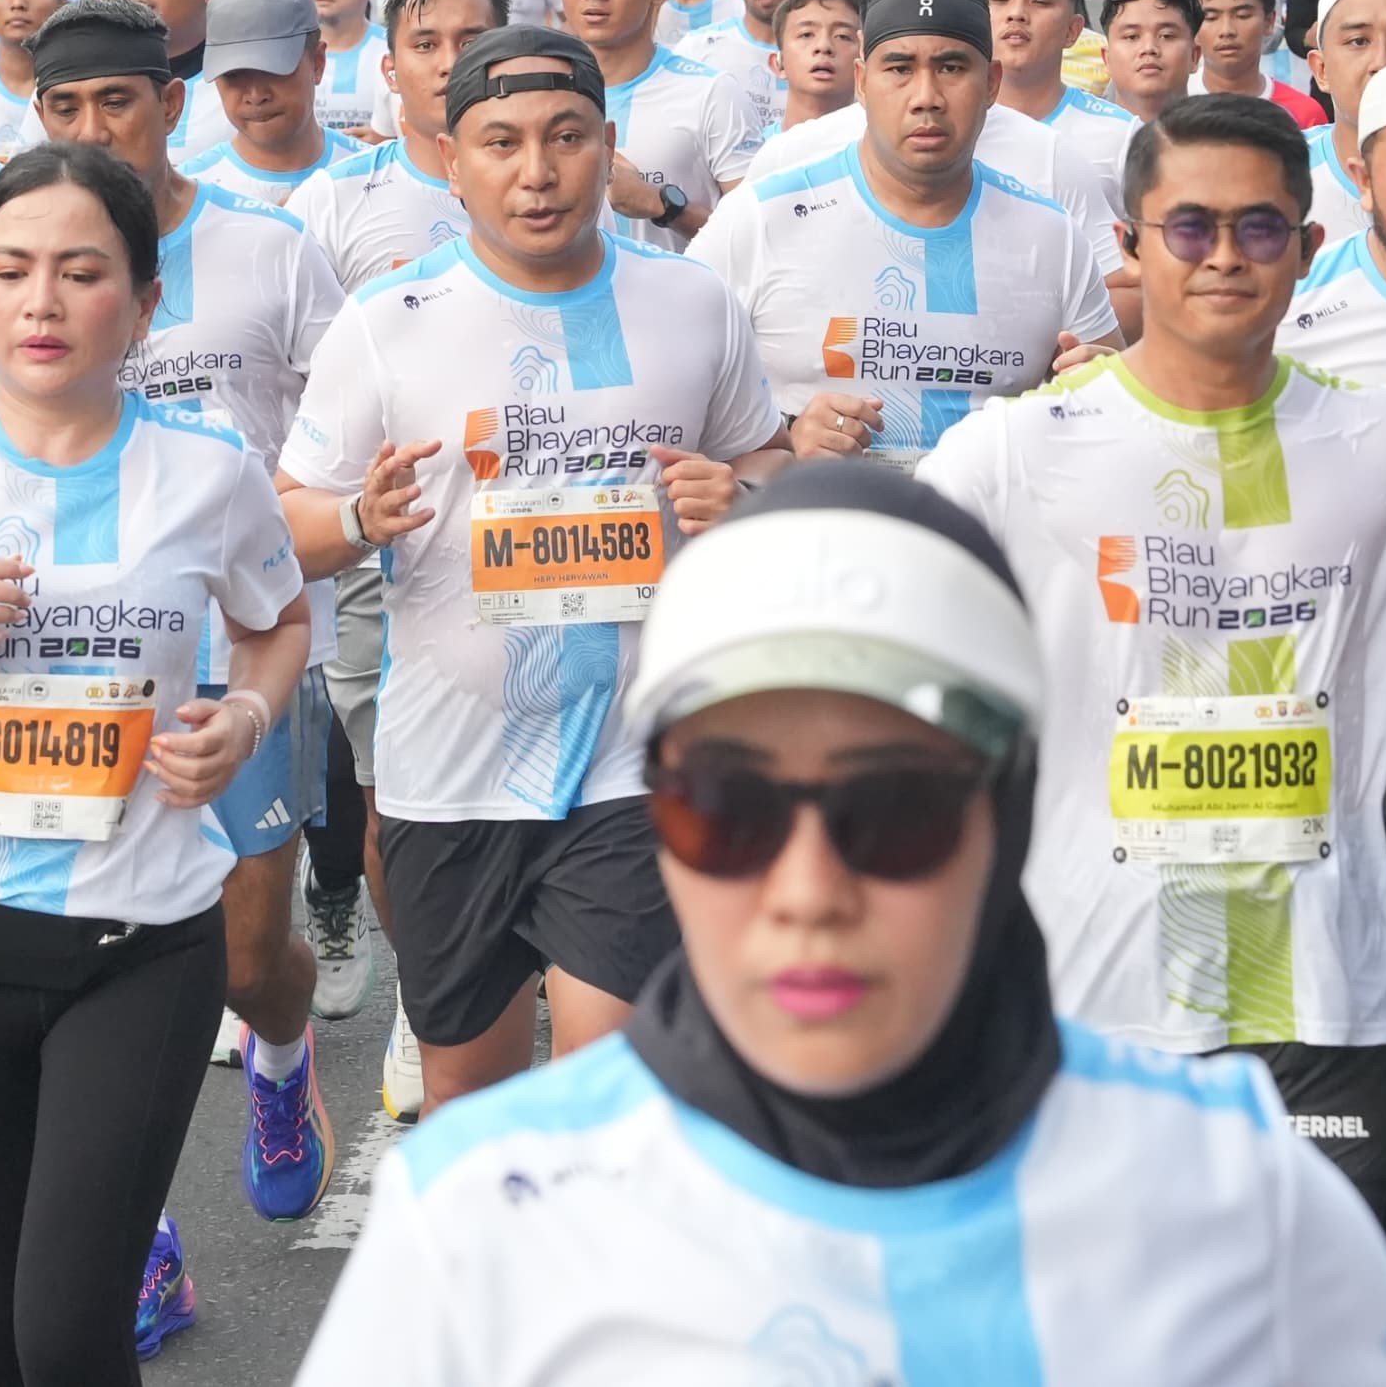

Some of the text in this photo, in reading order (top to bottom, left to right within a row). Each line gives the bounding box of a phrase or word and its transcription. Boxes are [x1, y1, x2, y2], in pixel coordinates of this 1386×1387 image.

[1085, 99, 1116, 114] 10K
[997, 174, 1039, 198] 10K
[810, 199, 838, 212] MILLS
[422, 286, 454, 303] MILLS
[1316, 300, 1348, 320] MILLS
[863, 317, 918, 338] Riau
[862, 339, 1025, 367] Bhayangkara
[861, 361, 994, 385] Run 2026
[145, 375, 213, 399] 2026
[164, 408, 224, 434] 10K
[504, 404, 565, 427] Riau
[506, 419, 683, 454] Bhayangkara
[505, 450, 647, 478] Run 2026
[484, 522, 651, 568] M-8014583
[1144, 536, 1215, 567] Riau
[534, 574, 557, 583] HERY
[1147, 563, 1352, 600] Bhayangkara
[636, 586, 655, 599] 10
[1148, 599, 1317, 630] Run 2026
[39, 636, 142, 660] 2026
[1126, 741, 1318, 791] M-8021932
[1284, 1114, 1370, 1138] TERREL
